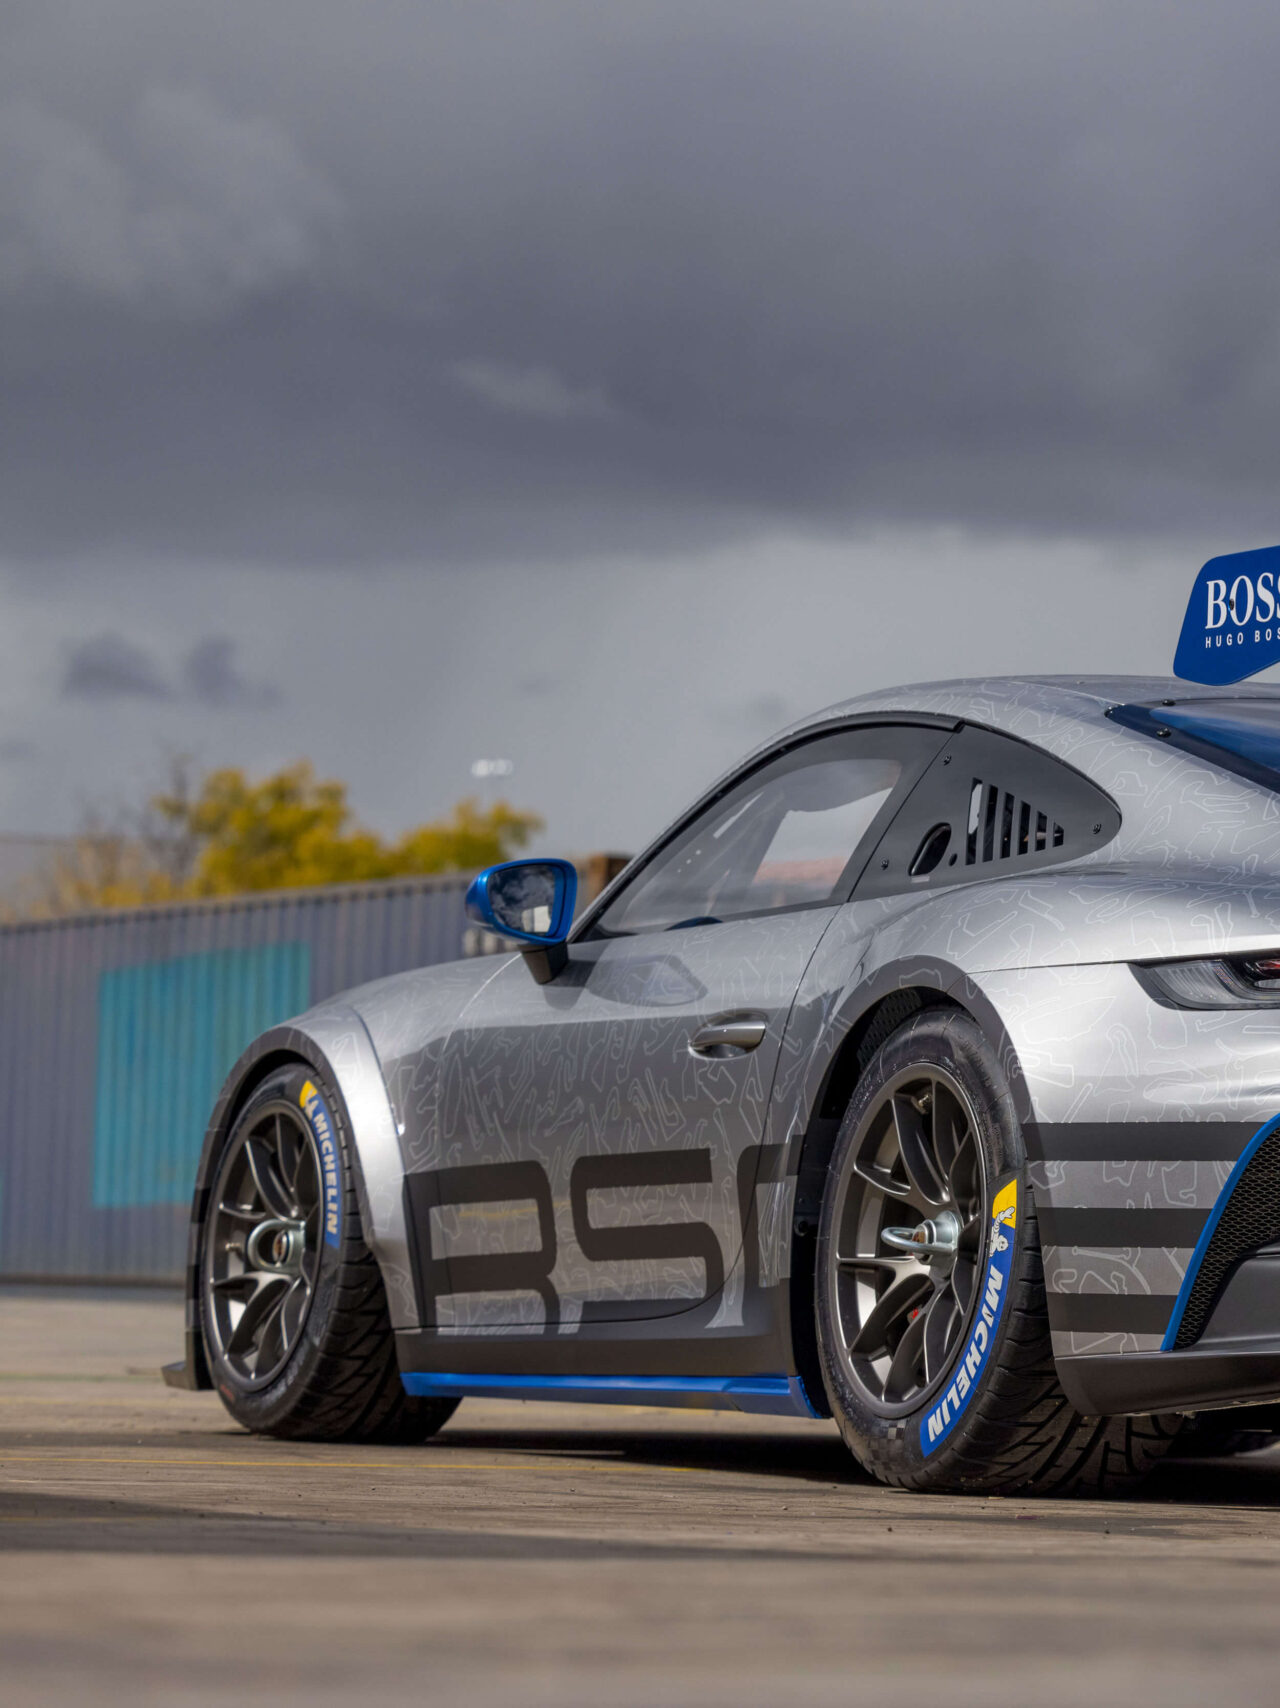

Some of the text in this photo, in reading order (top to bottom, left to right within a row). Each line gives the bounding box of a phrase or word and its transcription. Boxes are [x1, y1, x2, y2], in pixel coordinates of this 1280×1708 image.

[1205, 632, 1244, 648] HUGO
[312, 1111, 339, 1236] MICHELIN
[927, 1263, 1004, 1443] MICHELIN
